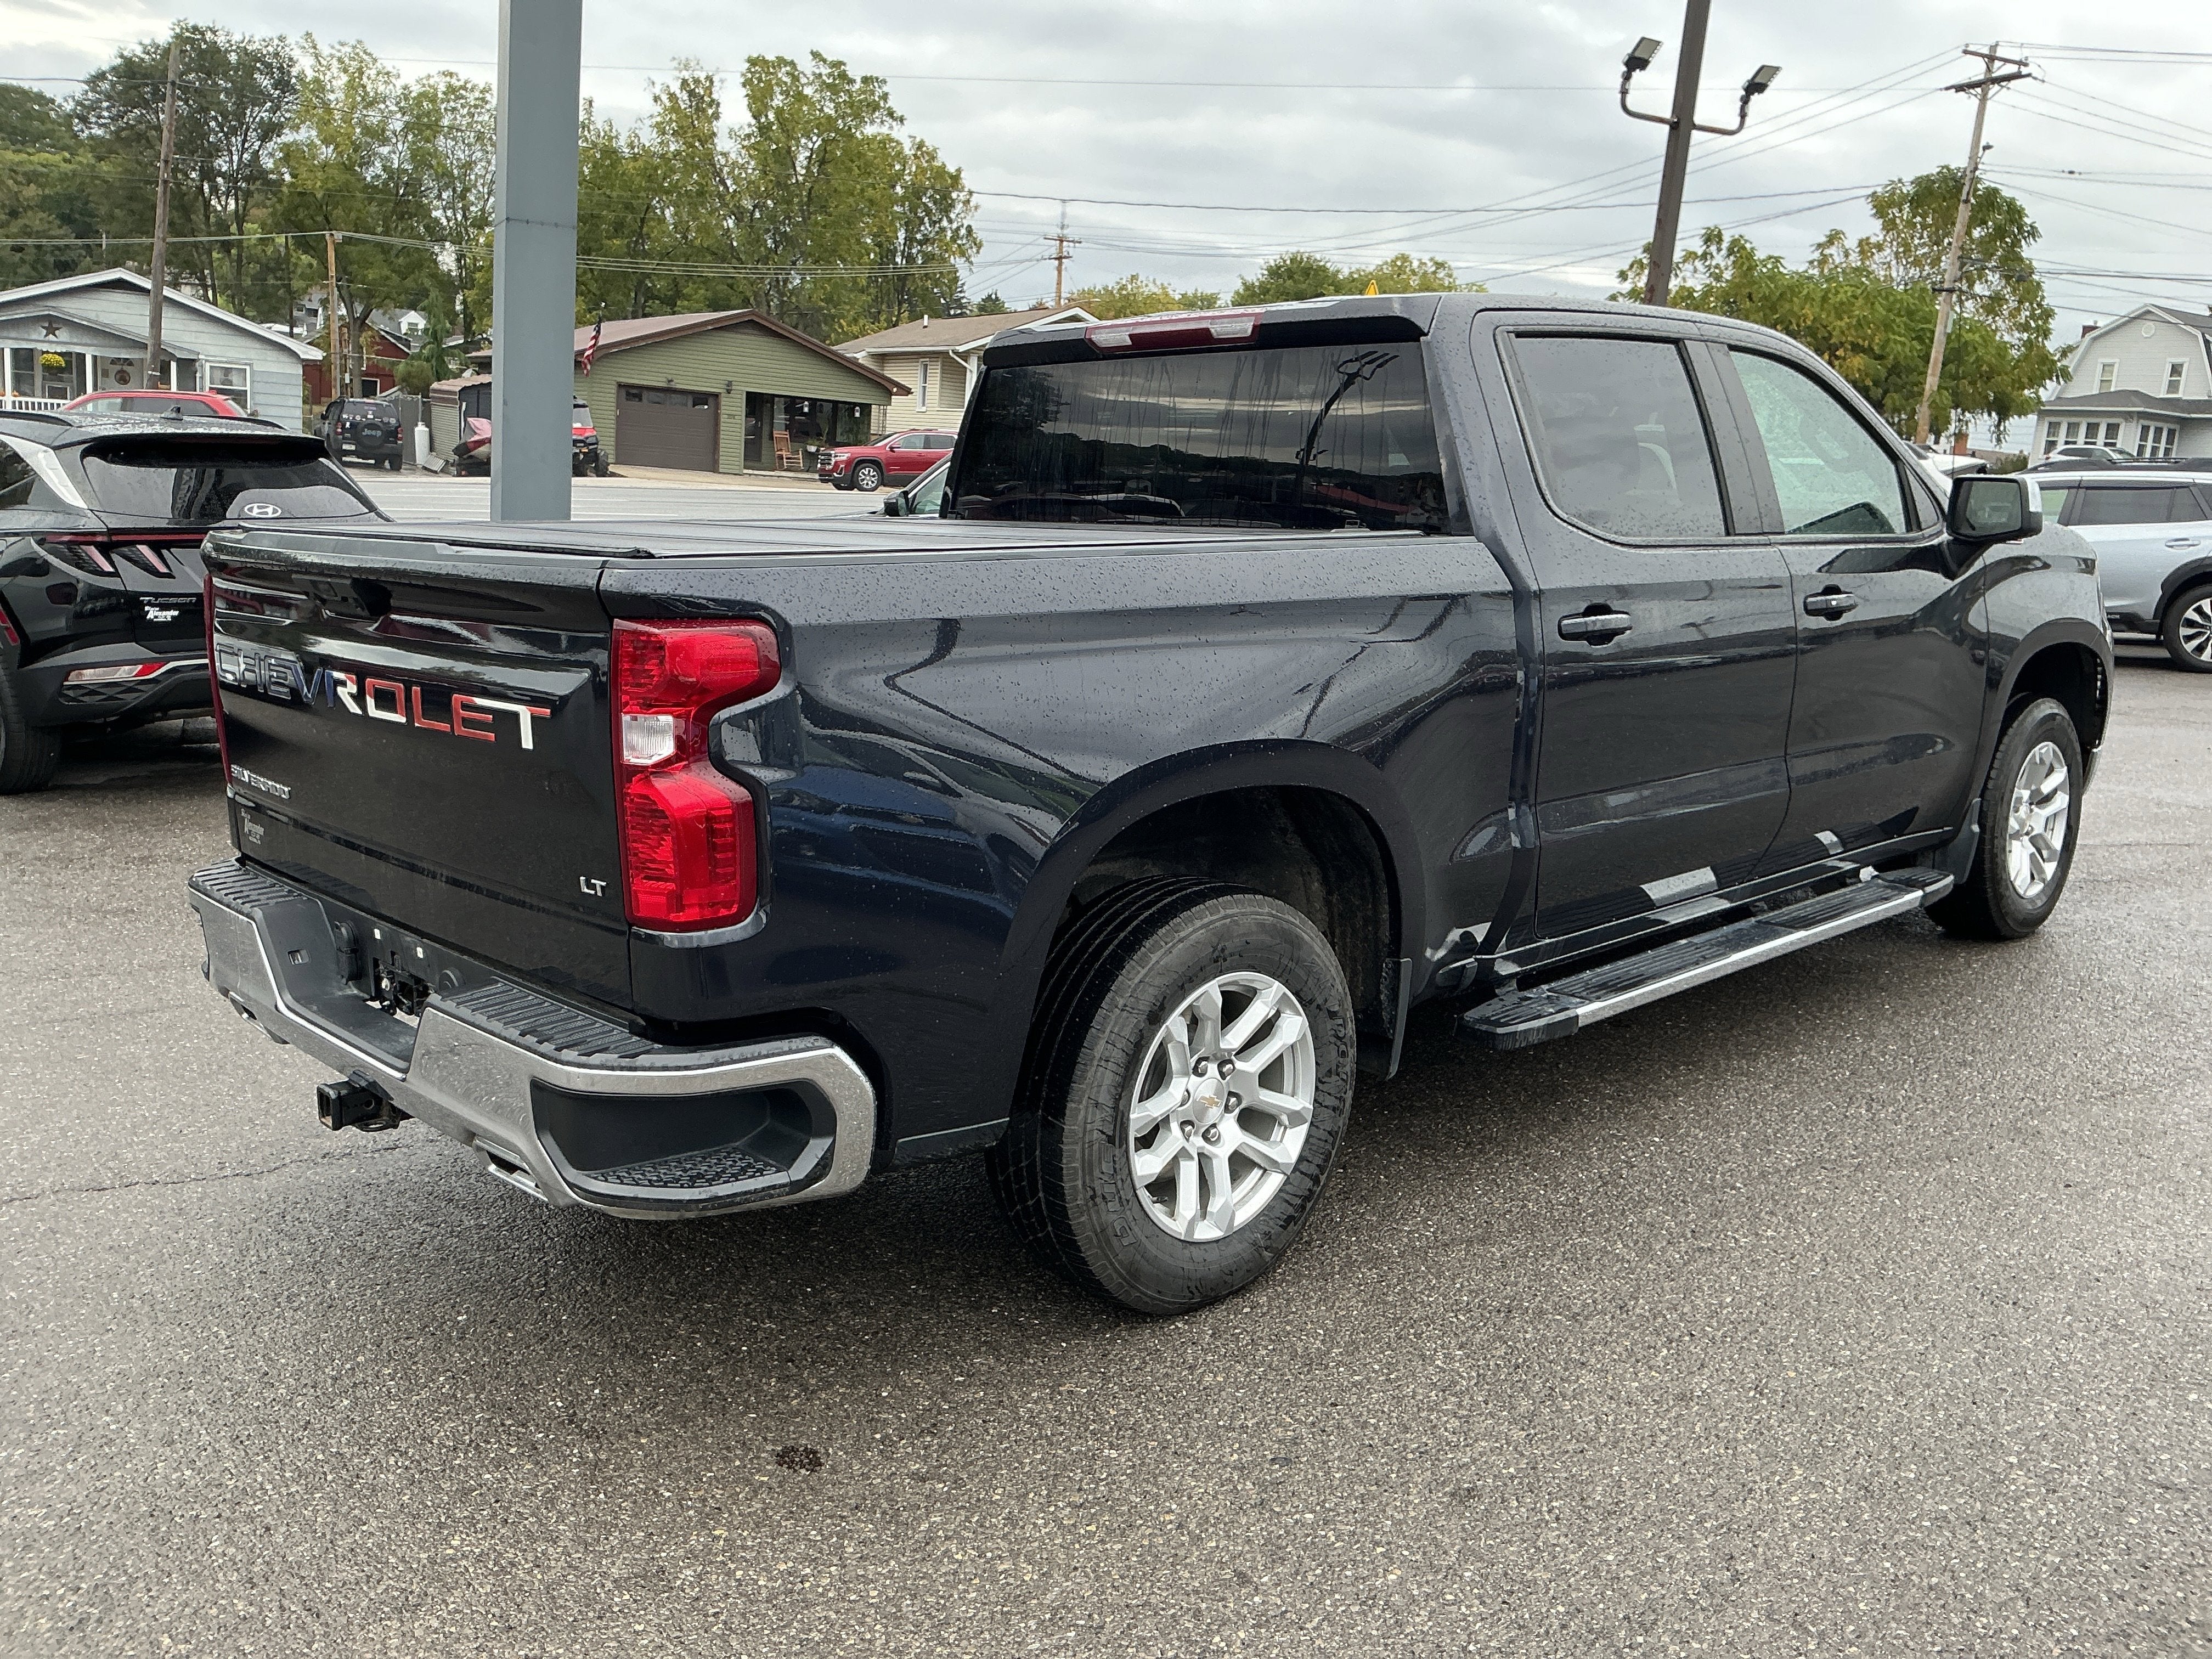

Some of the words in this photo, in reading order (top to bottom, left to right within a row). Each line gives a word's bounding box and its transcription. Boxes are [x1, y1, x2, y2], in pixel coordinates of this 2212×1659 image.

[362, 428, 382, 437] Jeep
[215, 643, 551, 751] CHEVROLET
[579, 876, 607, 897] LT
